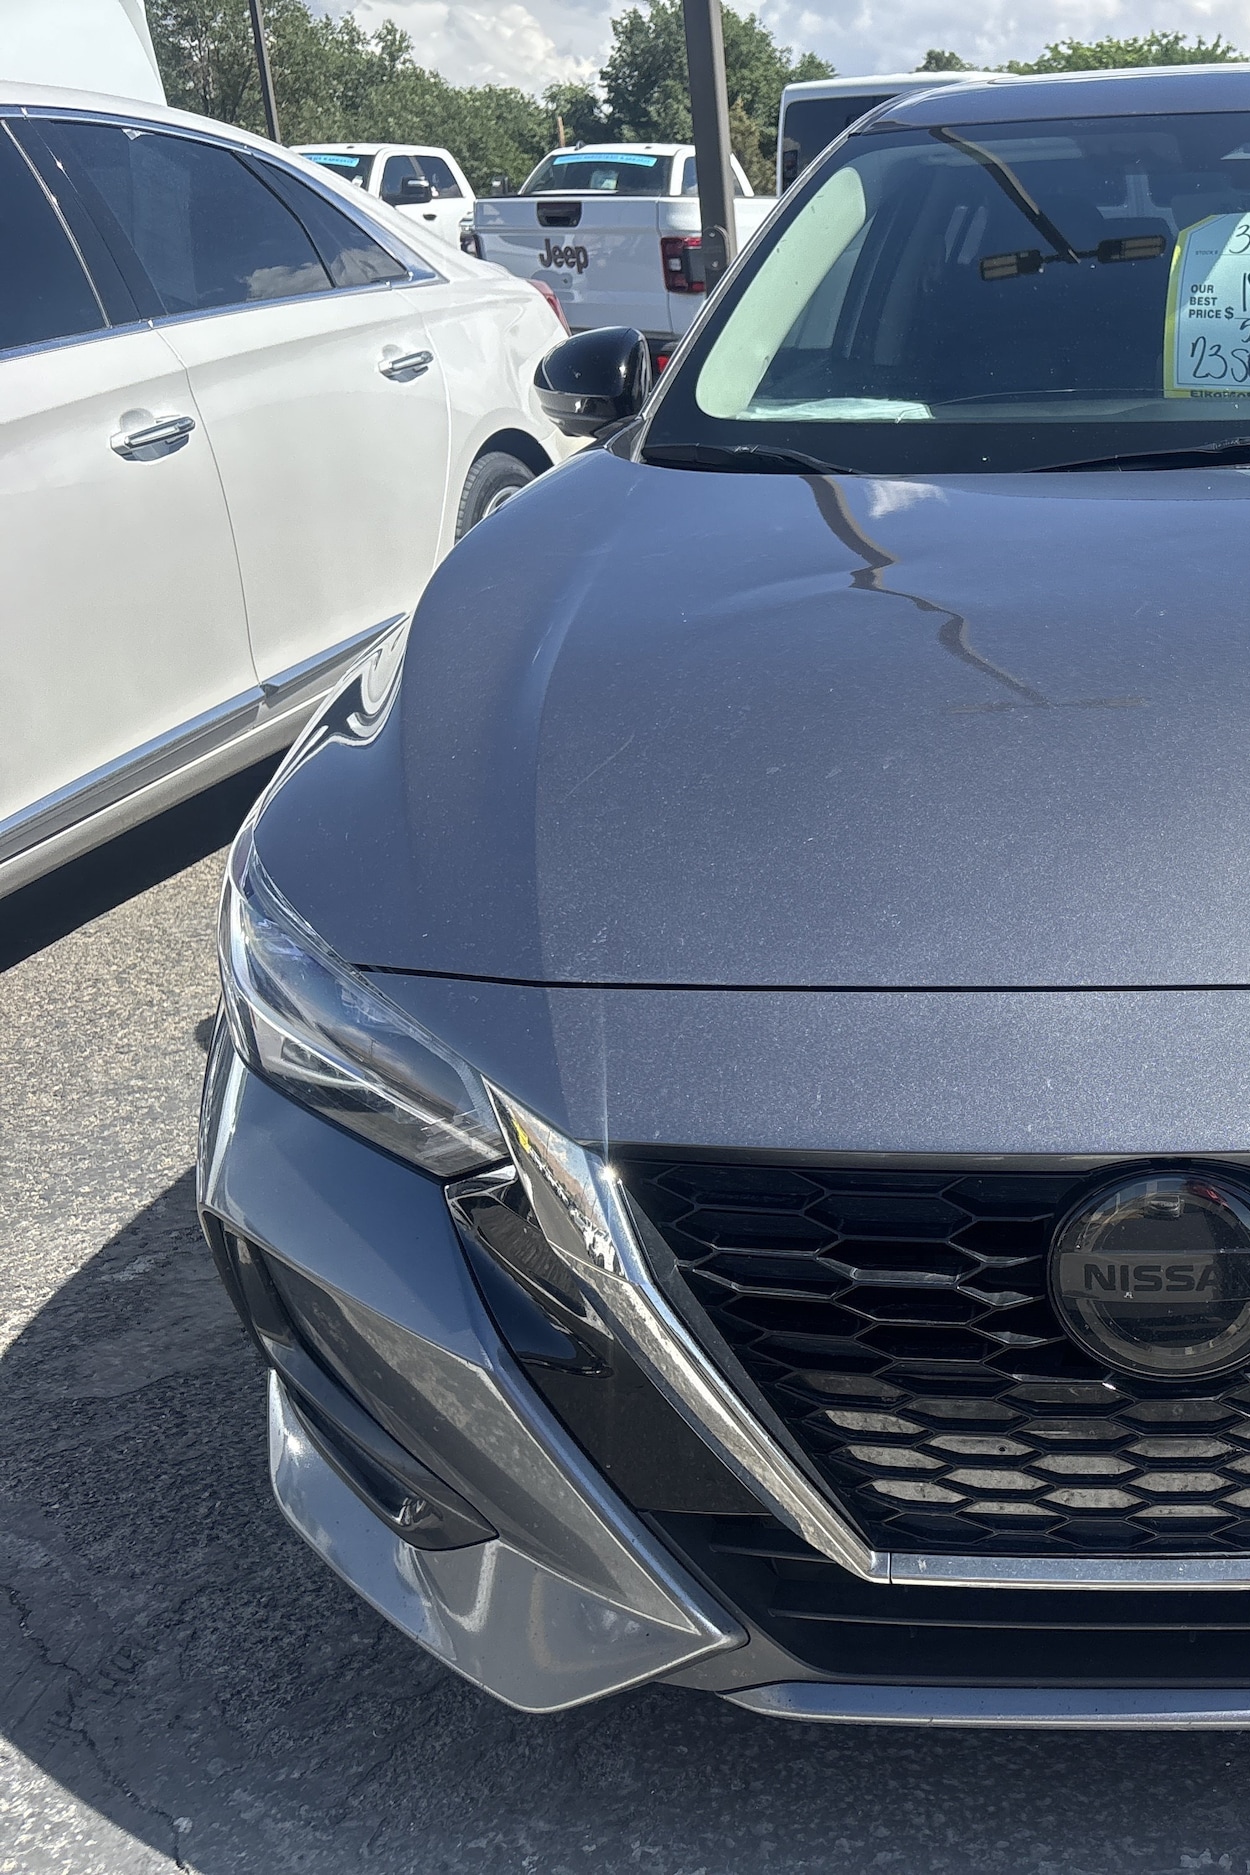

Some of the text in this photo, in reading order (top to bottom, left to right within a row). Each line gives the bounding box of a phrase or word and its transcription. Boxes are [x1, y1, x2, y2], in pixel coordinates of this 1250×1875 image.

[539, 238, 589, 275] Jeep
[1190, 284, 1215, 295] OUR
[1189, 297, 1218, 306] BEST
[1188, 309, 1222, 319] PRICE
